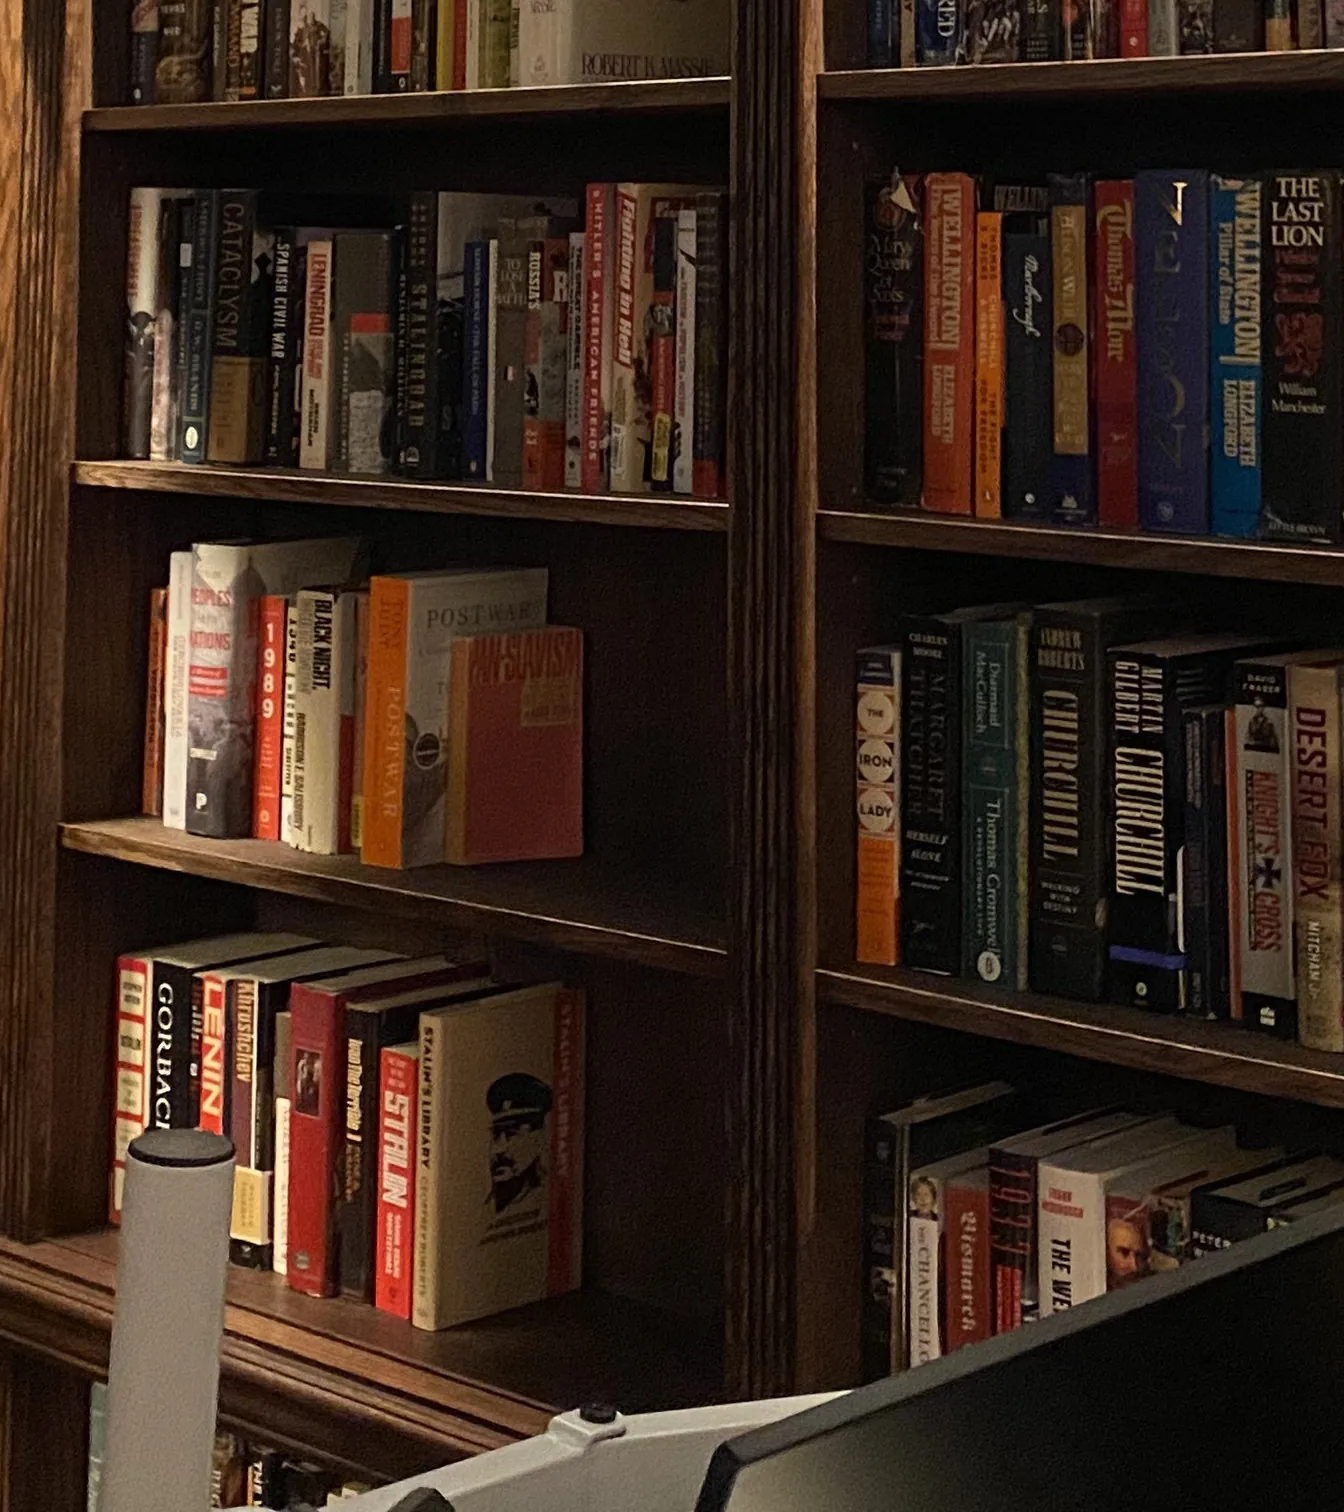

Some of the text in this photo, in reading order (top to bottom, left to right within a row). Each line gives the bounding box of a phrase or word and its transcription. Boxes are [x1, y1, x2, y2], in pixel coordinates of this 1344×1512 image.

[240, 5, 260, 54] WAR
[582, 53, 641, 77] ROBERT
[1272, 201, 1325, 223] LAST
[1275, 177, 1320, 199] THE
[216, 202, 247, 349] CATACLYSM
[941, 191, 962, 345] WELLINGTON
[1219, 222, 1234, 282] Pillar of
[1234, 192, 1262, 355] WELLINGTON
[1271, 225, 1325, 249] LION
[271, 243, 292, 359] SPANISH CIVIL WAR
[308, 252, 328, 337] LENINGRAD
[397, 274, 408, 333] BENJAMIN
[527, 251, 543, 310] RUSSIA'S
[574, 271, 582, 313] GREAT
[617, 199, 637, 365] Fighting Hell
[1096, 199, 1134, 364] Thomas More
[408, 283, 429, 427] STALINGRAD
[587, 203, 605, 461] HITLER'S AMERICAN FRIENDS
[190, 354, 202, 412] BRANDS
[941, 365, 955, 445] ELIZABETH
[1223, 379, 1239, 458] LONGFORD
[1239, 379, 1257, 467] ELIZABETH
[1277, 381, 1317, 399] William
[310, 598, 333, 691] BLACK NIGHT,
[426, 601, 533, 629] POSTWAR
[262, 620, 276, 720] 1989
[975, 650, 989, 735] MacCulloch
[987, 662, 1002, 729] Diarmaid
[1115, 660, 1140, 734] GILBERT
[1140, 664, 1165, 734] MARTIN
[383, 684, 404, 818] POSTWAR
[867, 707, 885, 719] THE
[908, 668, 926, 819] THATCHER
[927, 671, 946, 824] MARGARET
[293, 711, 307, 831] HARRISON SALISBURY
[859, 755, 893, 768] IRON
[1042, 688, 1080, 861] CHURCHILL
[1296, 706, 1330, 901] DESERT FOX
[859, 804, 892, 818] LADY
[985, 798, 1002, 869] Thomas
[1115, 746, 1165, 897] CHURCHILL
[1253, 770, 1283, 953] KNIGHT'S CROSS
[1307, 920, 1322, 983] MITCHAM
[202, 979, 224, 1118] LENIN
[236, 982, 256, 1083] Khrushchev
[348, 1038, 363, 1064] Ivan
[348, 1064, 363, 1085] The
[346, 1085, 363, 1134] Terrible
[419, 1025, 435, 1171] STALIN'S LIBRARY
[556, 1093, 571, 1179] LIBRARY
[382, 1090, 411, 1208] STALIN
[959, 1210, 978, 1333] Bismarck
[1052, 1238, 1072, 1274] THE
